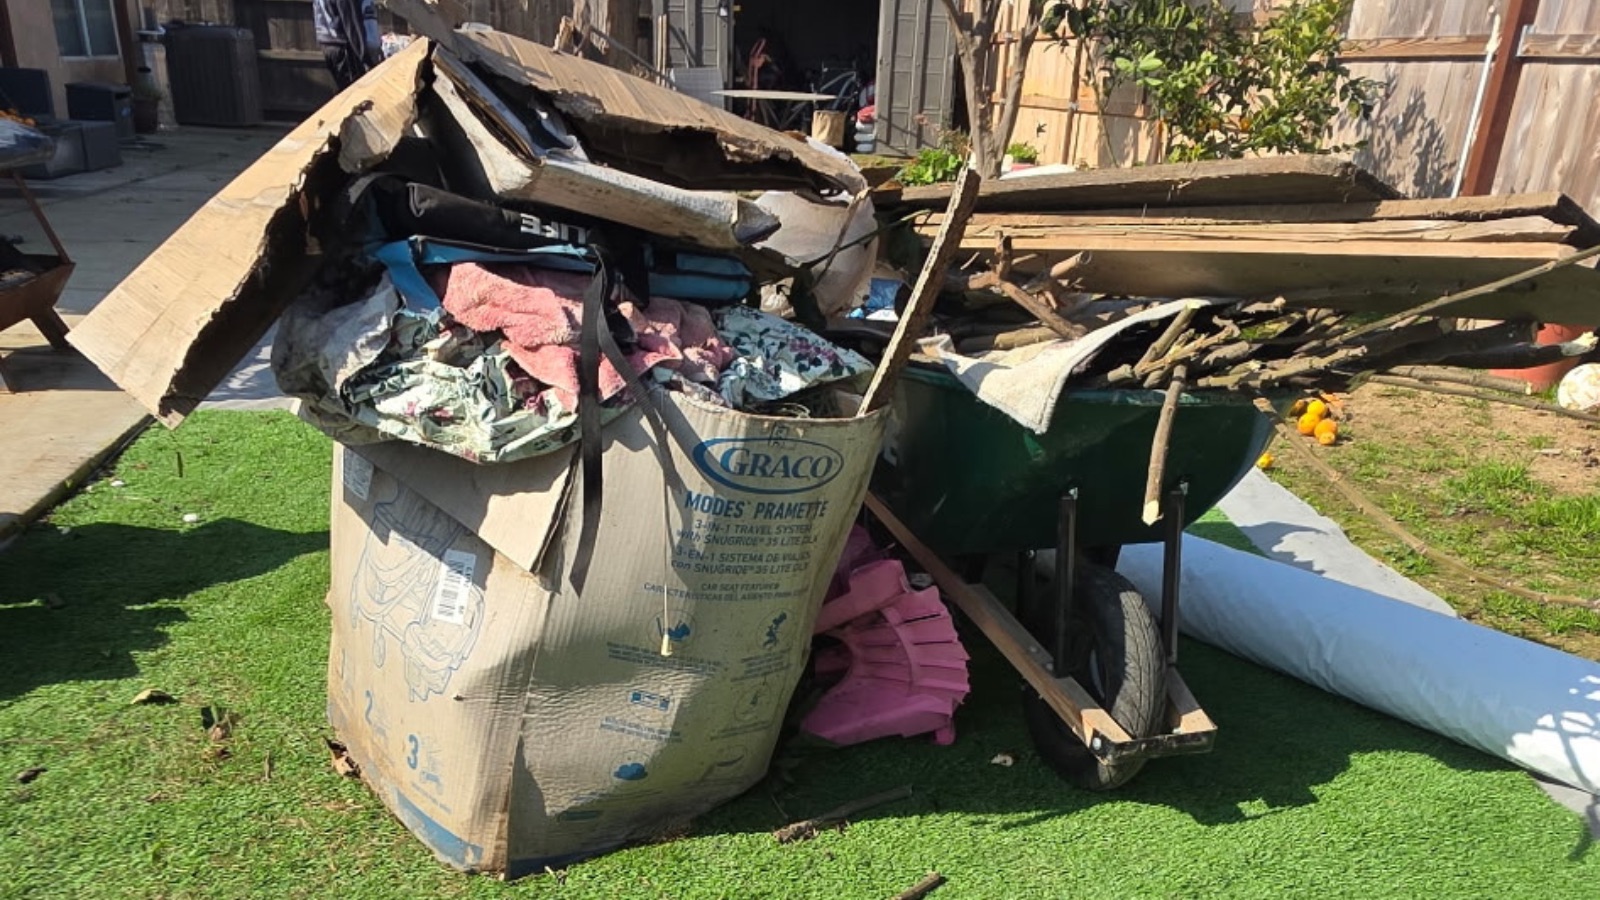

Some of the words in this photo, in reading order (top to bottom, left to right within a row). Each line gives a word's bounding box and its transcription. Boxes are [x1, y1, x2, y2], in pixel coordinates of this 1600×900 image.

[720, 447, 833, 481] GRACO
[753, 500, 830, 521] PRAMETTE
[734, 524, 773, 536] TRAVEL
[717, 552, 764, 564] SISTEMA
[765, 553, 780, 563] DE
[407, 733, 419, 770] 3
